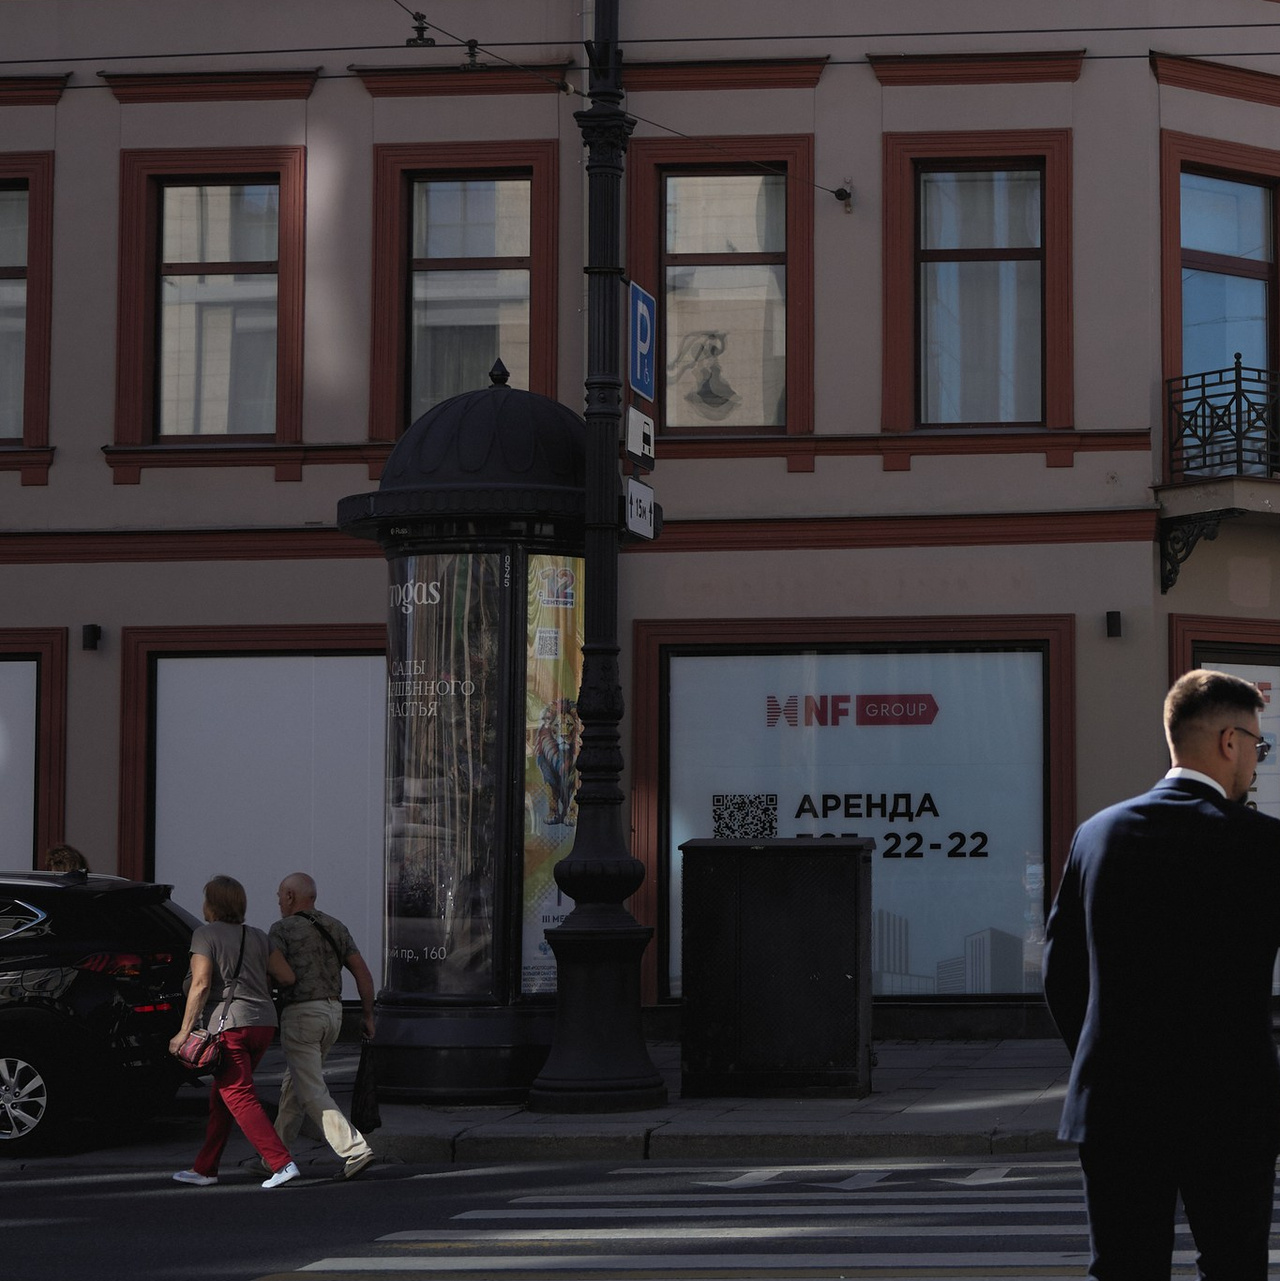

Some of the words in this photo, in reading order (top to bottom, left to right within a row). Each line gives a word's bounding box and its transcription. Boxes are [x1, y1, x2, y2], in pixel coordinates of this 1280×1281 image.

[541, 568, 575, 600] 12
[392, 660, 426, 677] САДЫ
[865, 703, 928, 717] GROUP
[794, 793, 940, 822] АРЕНДА
[423, 946, 447, 960] 160
